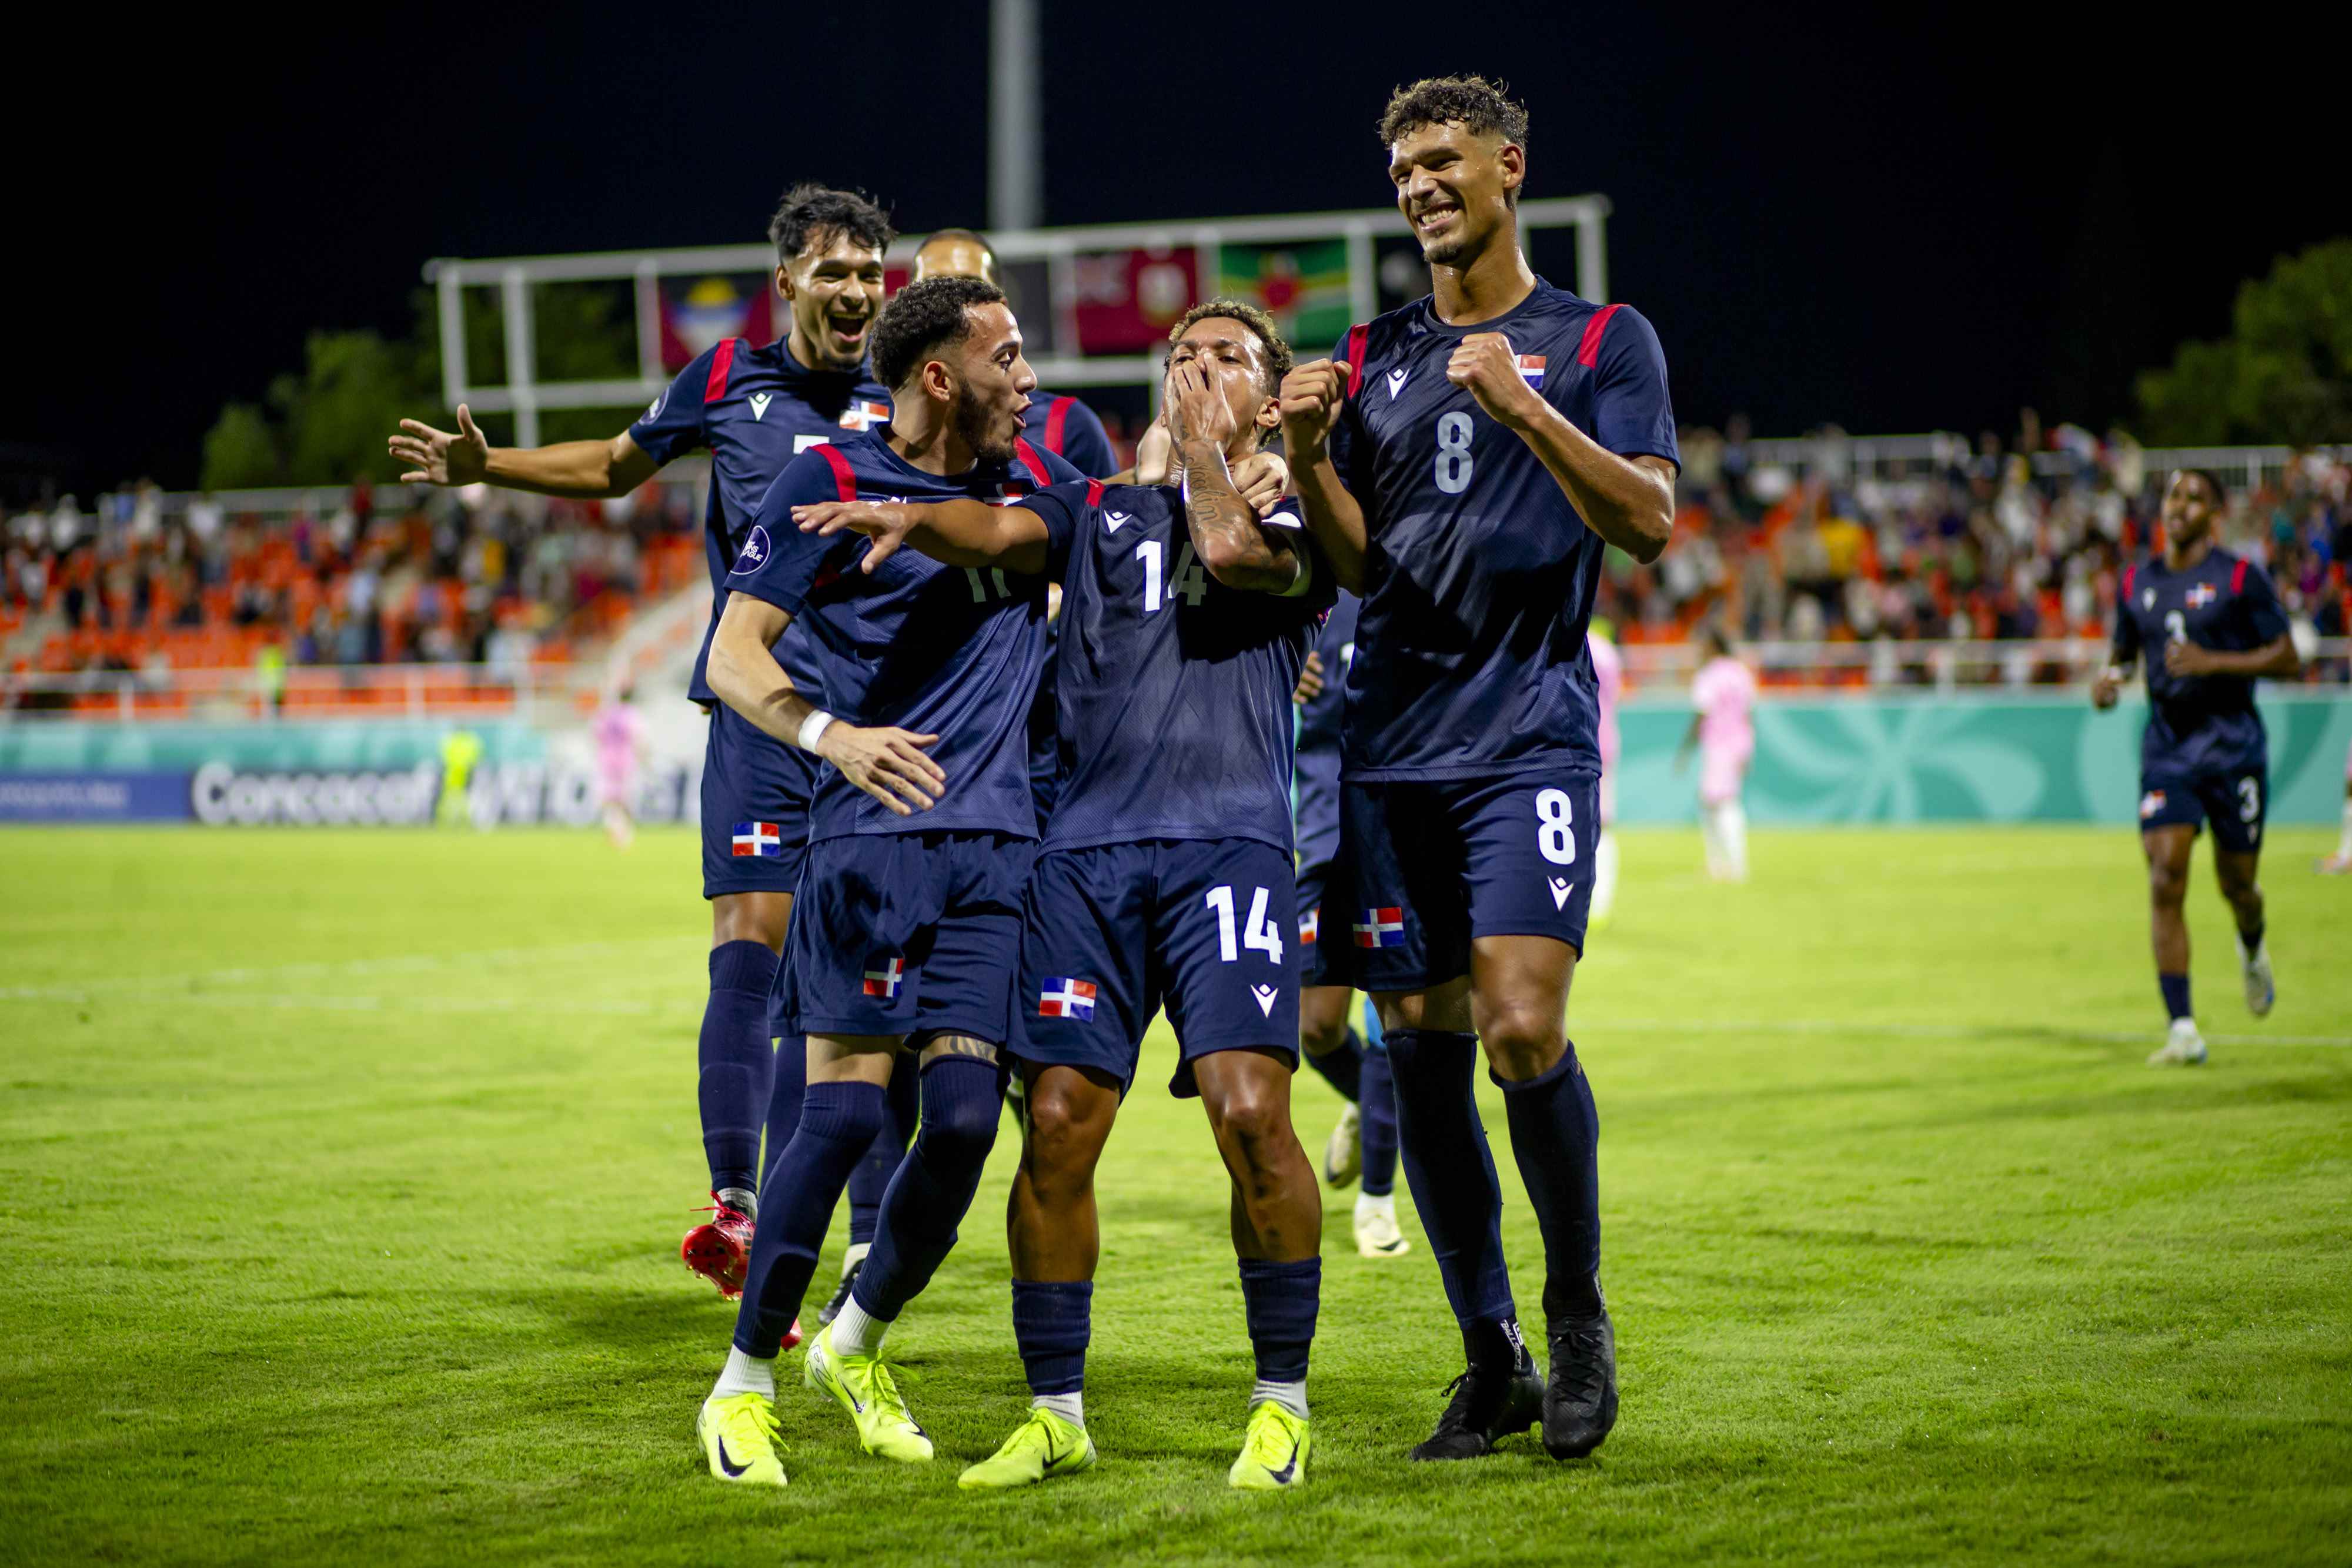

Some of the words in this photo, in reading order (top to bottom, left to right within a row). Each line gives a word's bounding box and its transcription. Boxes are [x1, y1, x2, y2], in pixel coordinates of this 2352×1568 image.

[1435, 412, 1474, 493] 8
[1136, 540, 1207, 611] 14
[1536, 788, 1575, 865] 8
[2237, 775, 2260, 823] 3
[1205, 885, 1283, 965] 14
